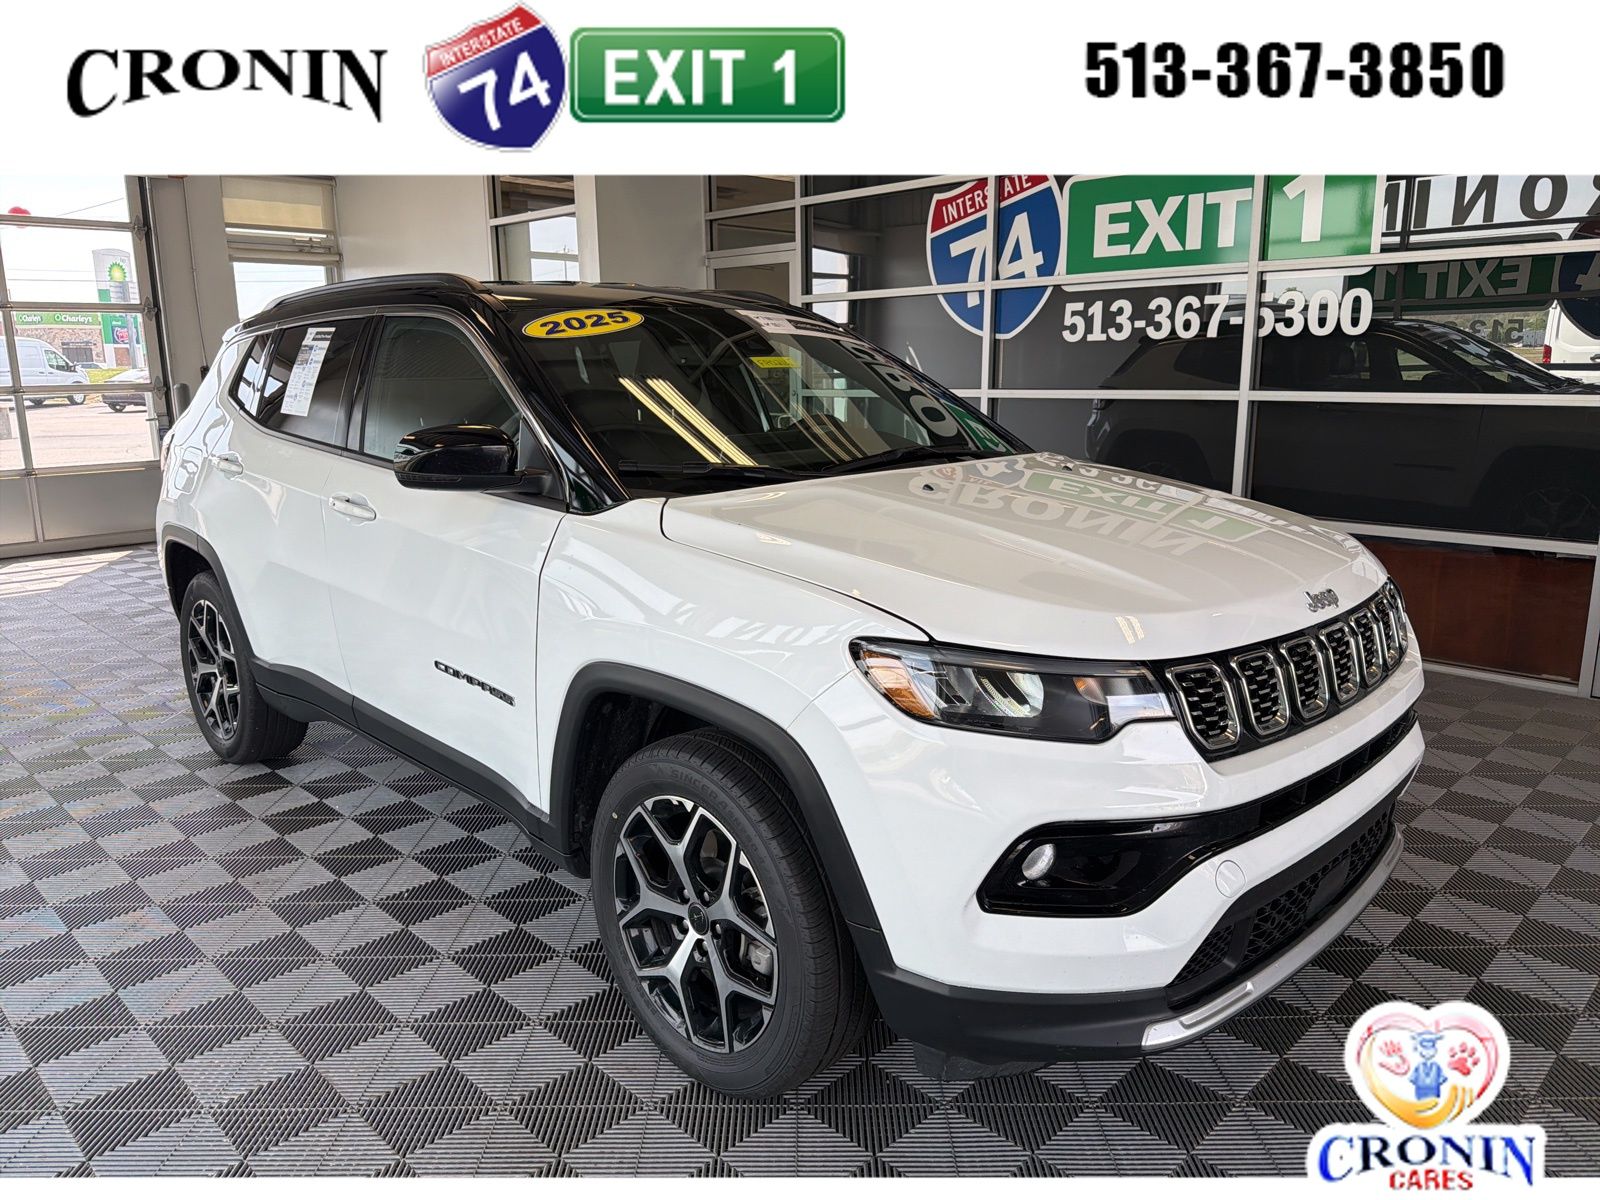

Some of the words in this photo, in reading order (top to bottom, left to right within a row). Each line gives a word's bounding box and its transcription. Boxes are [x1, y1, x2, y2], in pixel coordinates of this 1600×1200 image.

[1093, 187, 1253, 258] EXIT
[1282, 175, 1325, 242] 1
[949, 211, 1044, 308] 74
[61, 315, 92, 324] Charleys
[540, 312, 629, 336] 2025
[1062, 287, 1373, 343] 513-367-5300
[1303, 588, 1339, 612] Jeep
[434, 660, 516, 706] COMPASS
